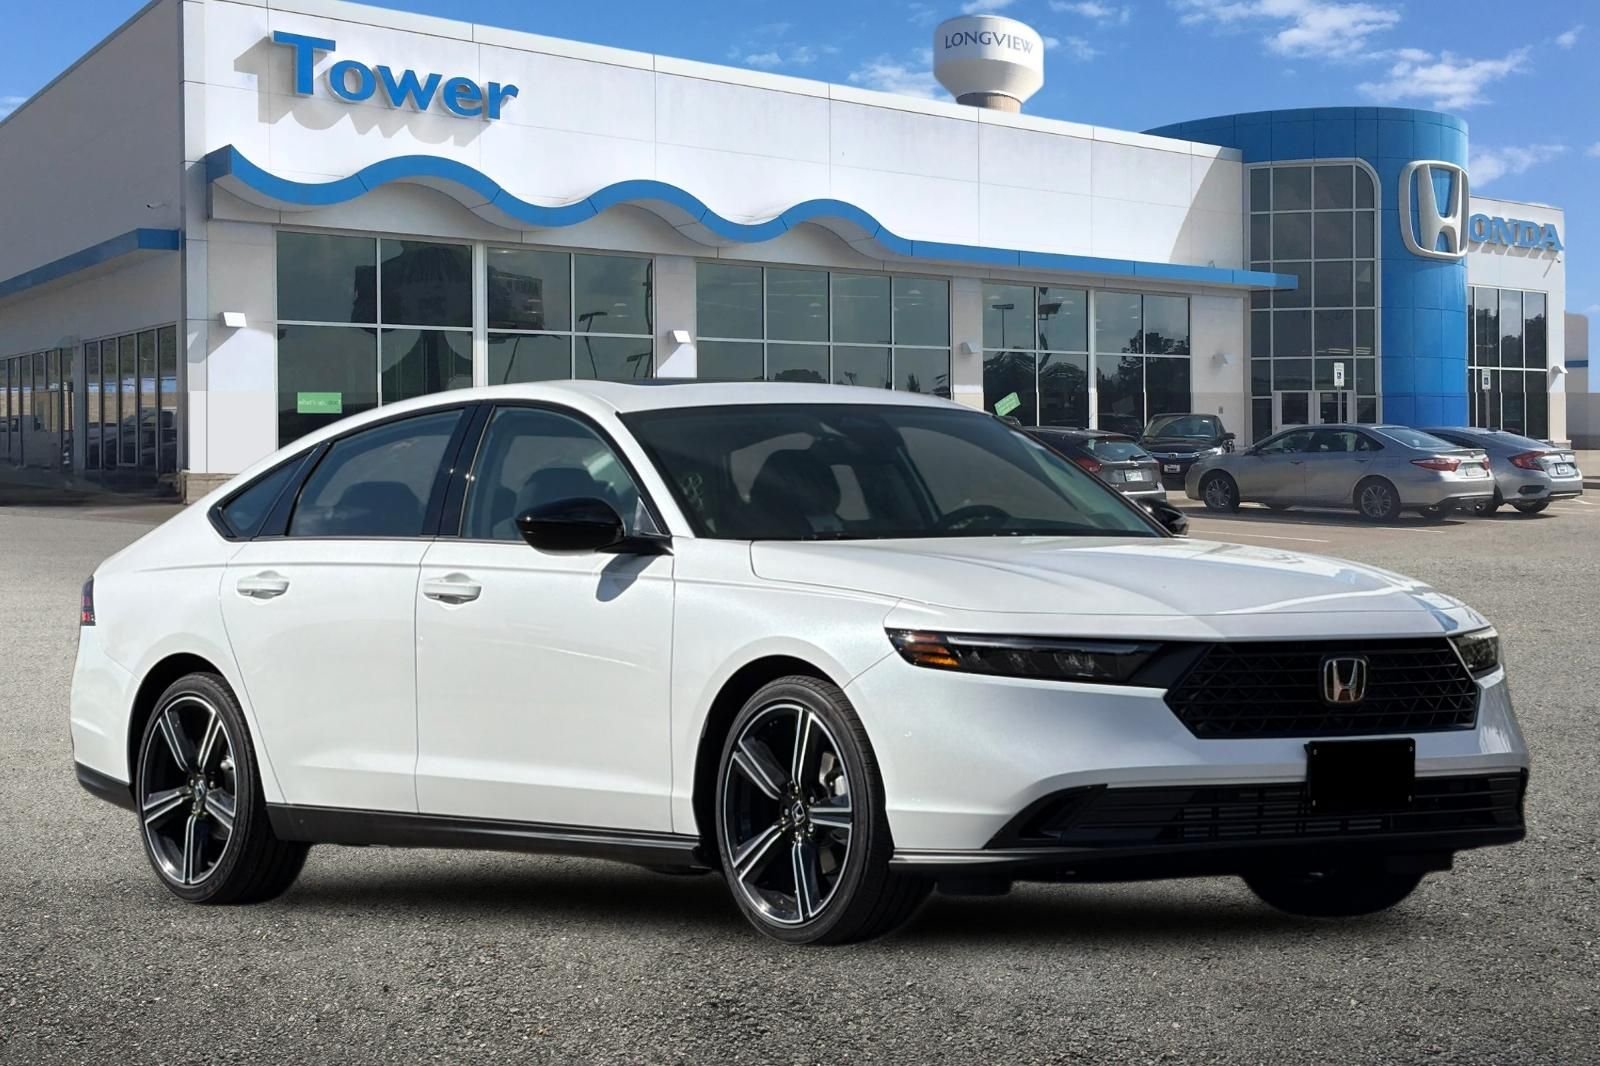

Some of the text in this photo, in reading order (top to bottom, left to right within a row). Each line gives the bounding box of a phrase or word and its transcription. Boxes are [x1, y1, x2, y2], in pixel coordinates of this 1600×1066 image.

[945, 31, 1034, 54] LONGVIEW
[273, 30, 519, 120] Tower
[1468, 213, 1564, 251] ONDA
